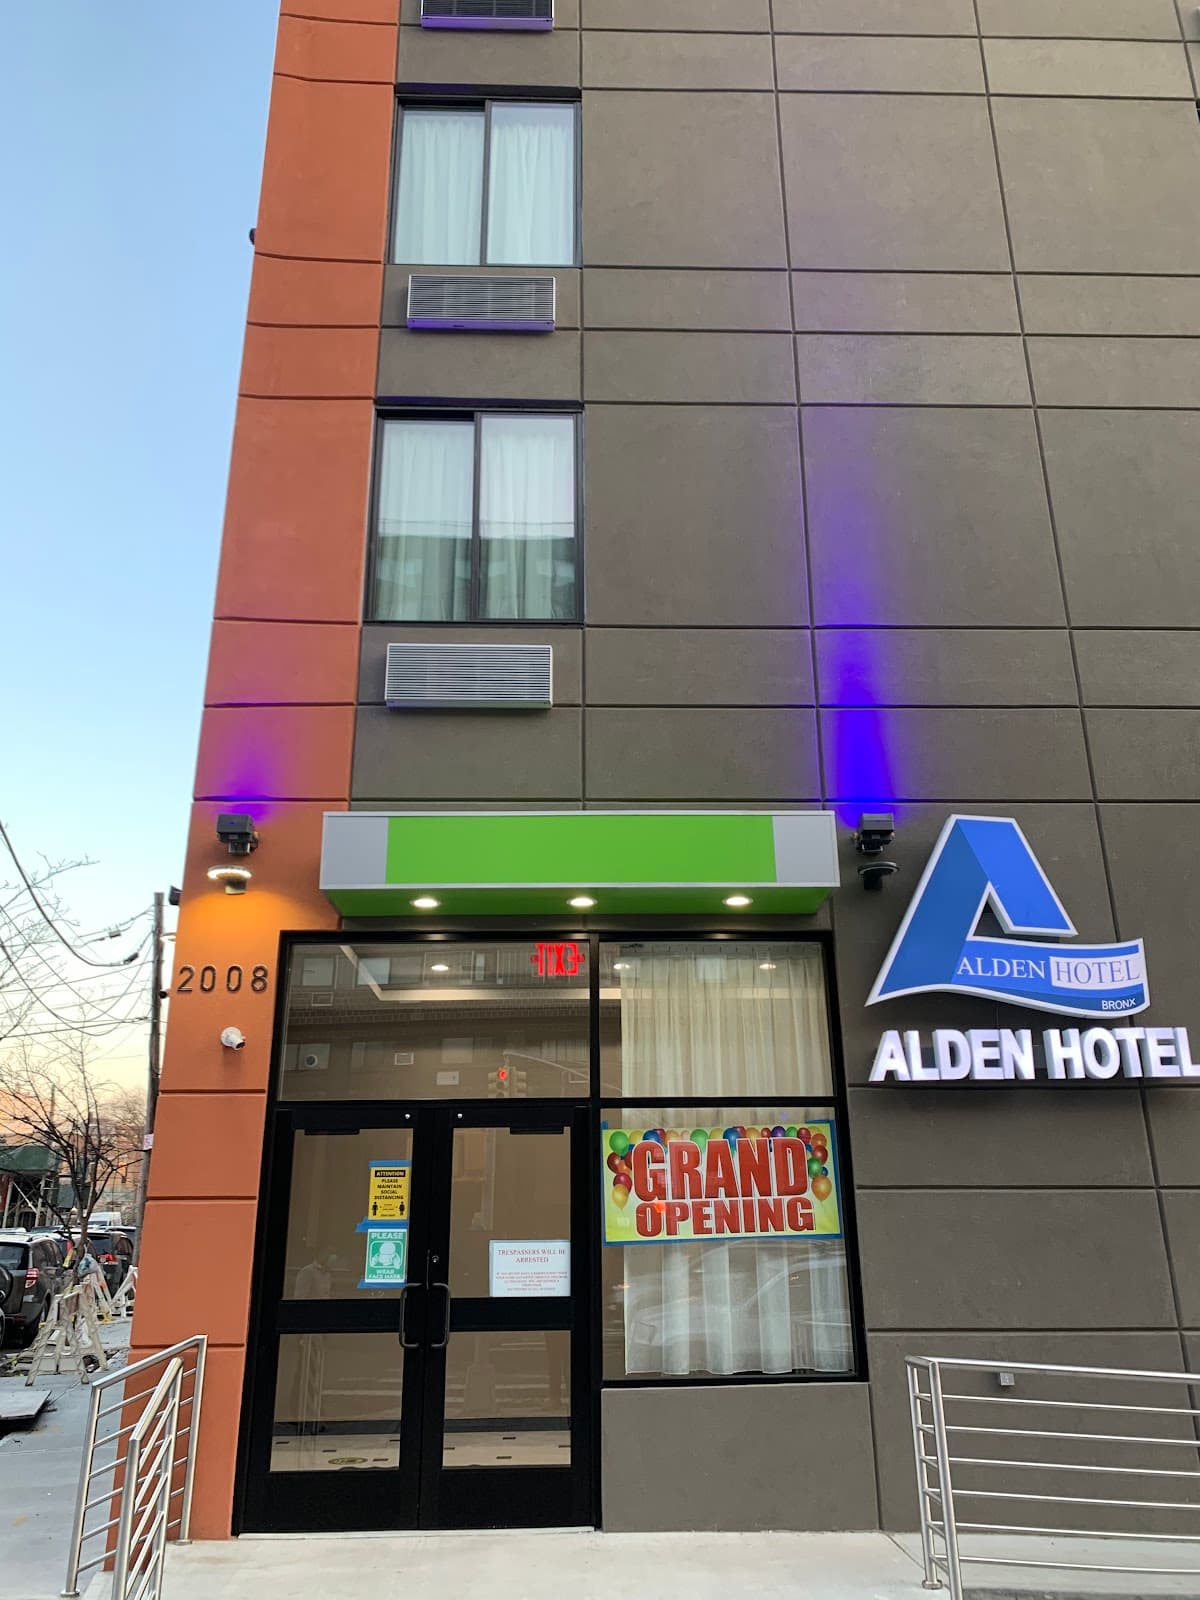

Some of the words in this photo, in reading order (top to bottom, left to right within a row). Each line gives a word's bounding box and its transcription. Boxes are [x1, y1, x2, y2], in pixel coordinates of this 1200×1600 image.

[177, 964, 269, 993] 2008
[956, 956, 1046, 980] ALDEN
[1055, 959, 1141, 985] HOTEL
[1101, 997, 1137, 1010] BRONX
[868, 1029, 1036, 1082] ALDEN
[1042, 1026, 1200, 1079] HOTEL
[631, 1137, 809, 1202] GRAND
[635, 1196, 815, 1238] OPENING
[371, 1232, 404, 1240] PLEASE
